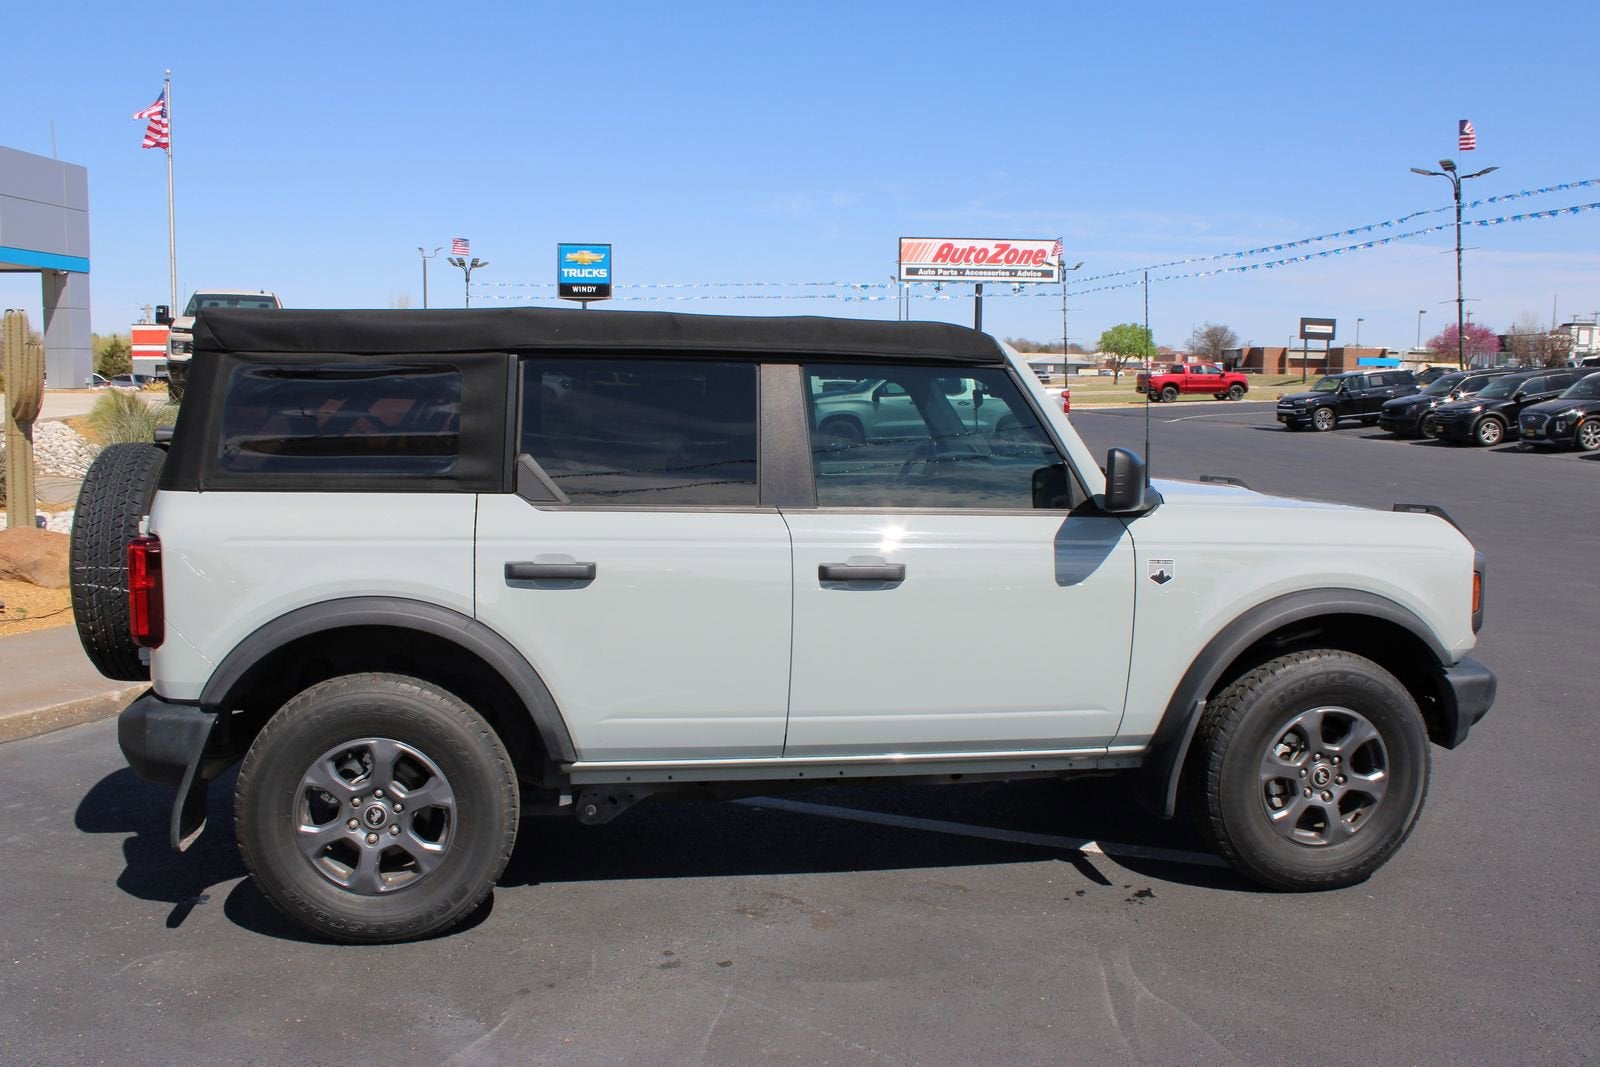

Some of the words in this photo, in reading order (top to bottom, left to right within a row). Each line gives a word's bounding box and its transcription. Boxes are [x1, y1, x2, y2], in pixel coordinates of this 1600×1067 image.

[931, 242, 1047, 266] AutoZone
[561, 268, 608, 278] TRUCKS
[918, 268, 936, 276] Auto
[964, 269, 1010, 277] Accessories
[572, 285, 597, 293] WINDY
